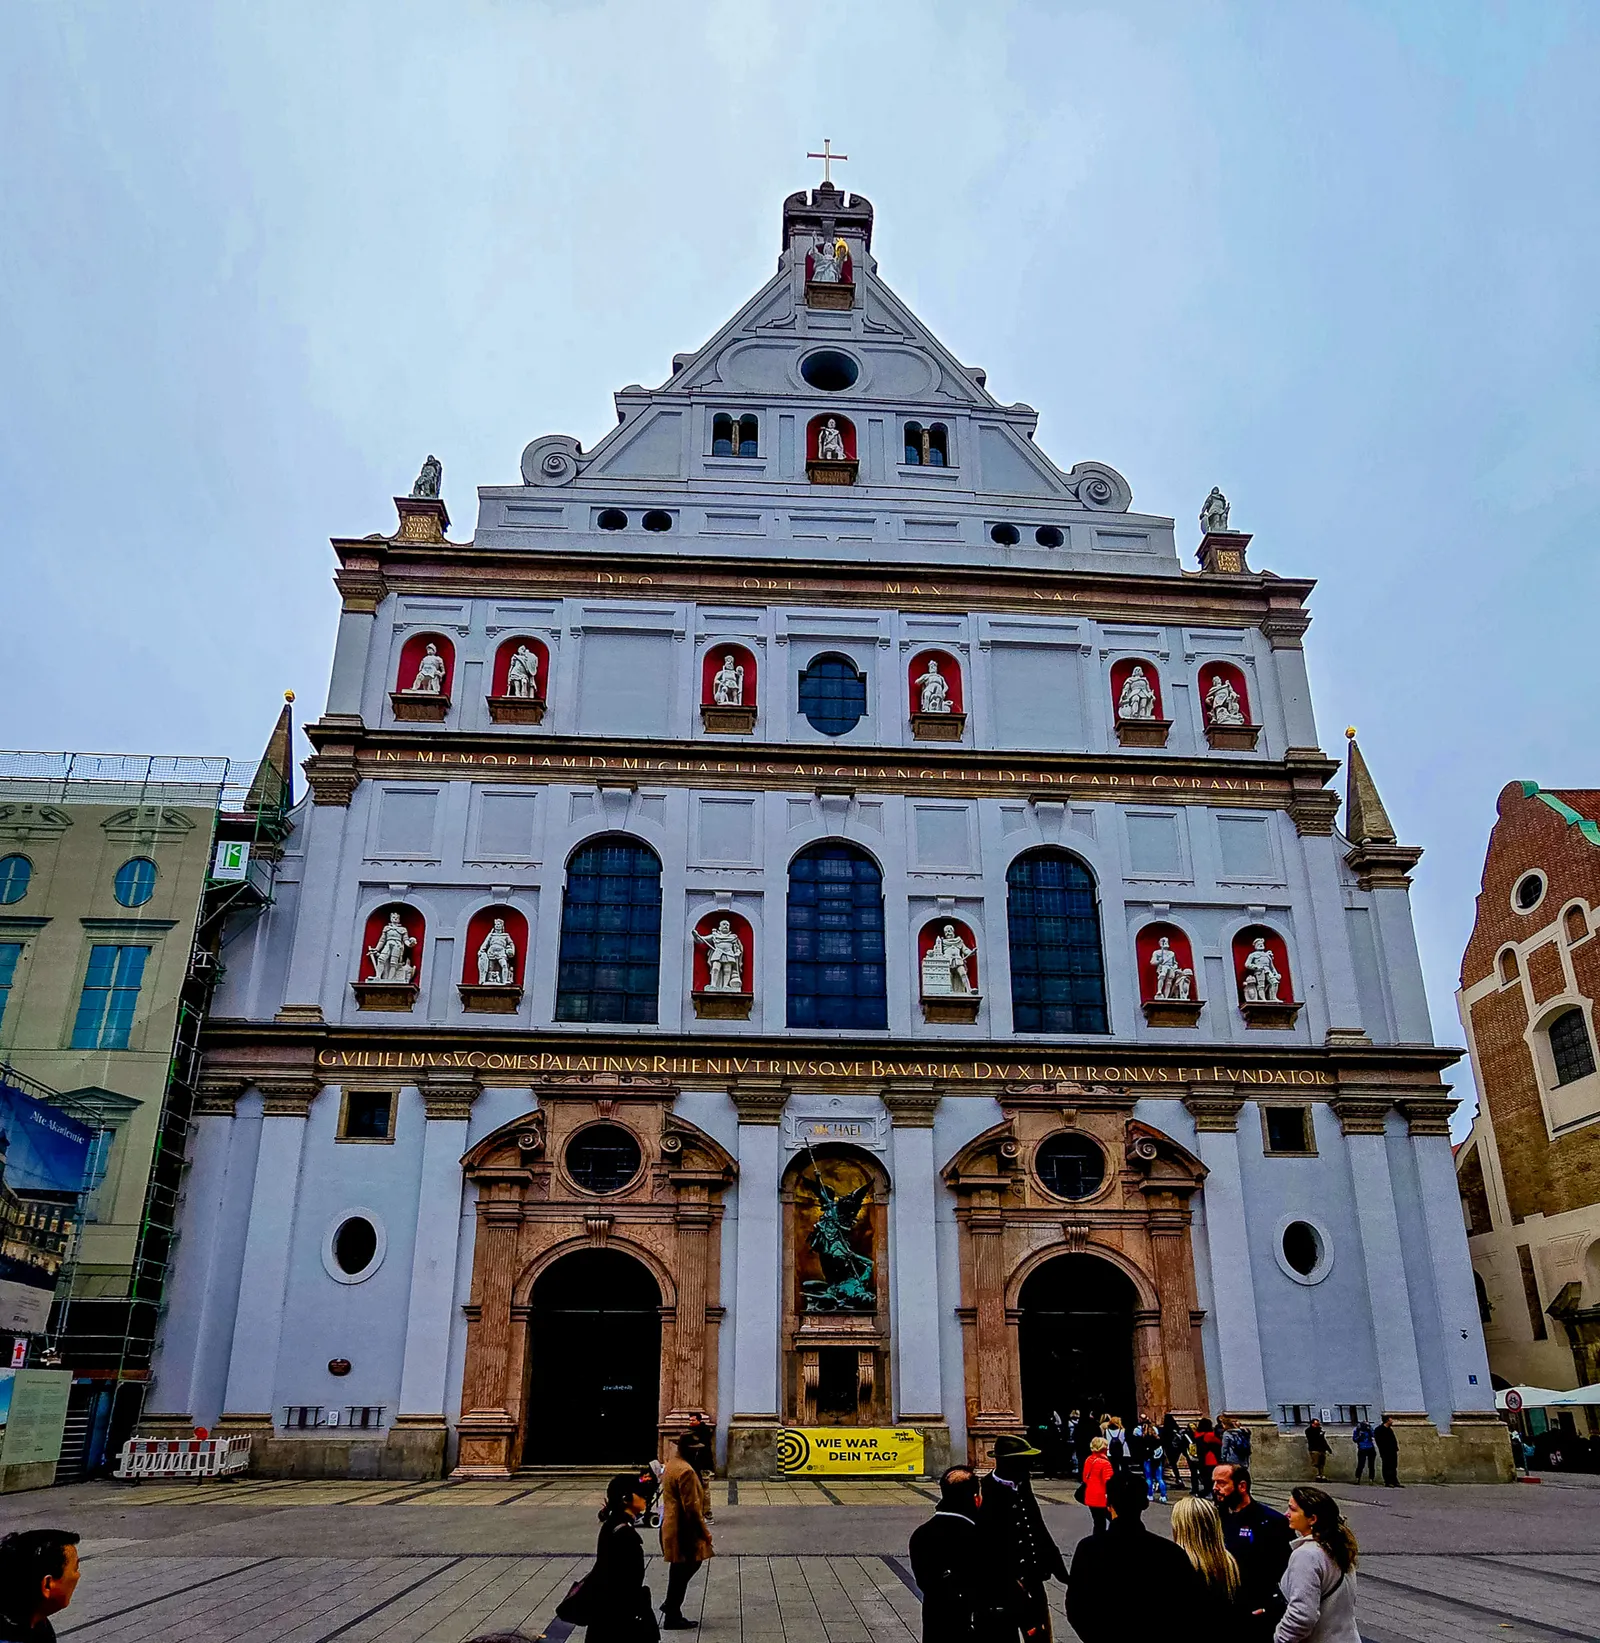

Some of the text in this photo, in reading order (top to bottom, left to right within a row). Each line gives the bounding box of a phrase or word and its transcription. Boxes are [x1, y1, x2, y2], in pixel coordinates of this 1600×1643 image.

[375, 750, 401, 761] IN
[417, 751, 577, 767] MEMORIAM
[1152, 775, 1268, 791] CVRAVIT
[318, 1049, 452, 1067] GVILIELMVS
[467, 1051, 538, 1069] COMES
[540, 1053, 648, 1072] PALATINVS
[653, 1055, 731, 1073] RHENI
[733, 1057, 864, 1077] VTRIVSQVE
[973, 1062, 1031, 1080] DVX
[1042, 1063, 1168, 1082] PATRONVS
[1178, 1067, 1204, 1082] ET
[1213, 1066, 1329, 1085] FVNDATOR
[30, 1110, 85, 1145] Alte Akademie
[815, 1438, 878, 1448] WIE WAR
[829, 1451, 898, 1461] DEIN TAG?
